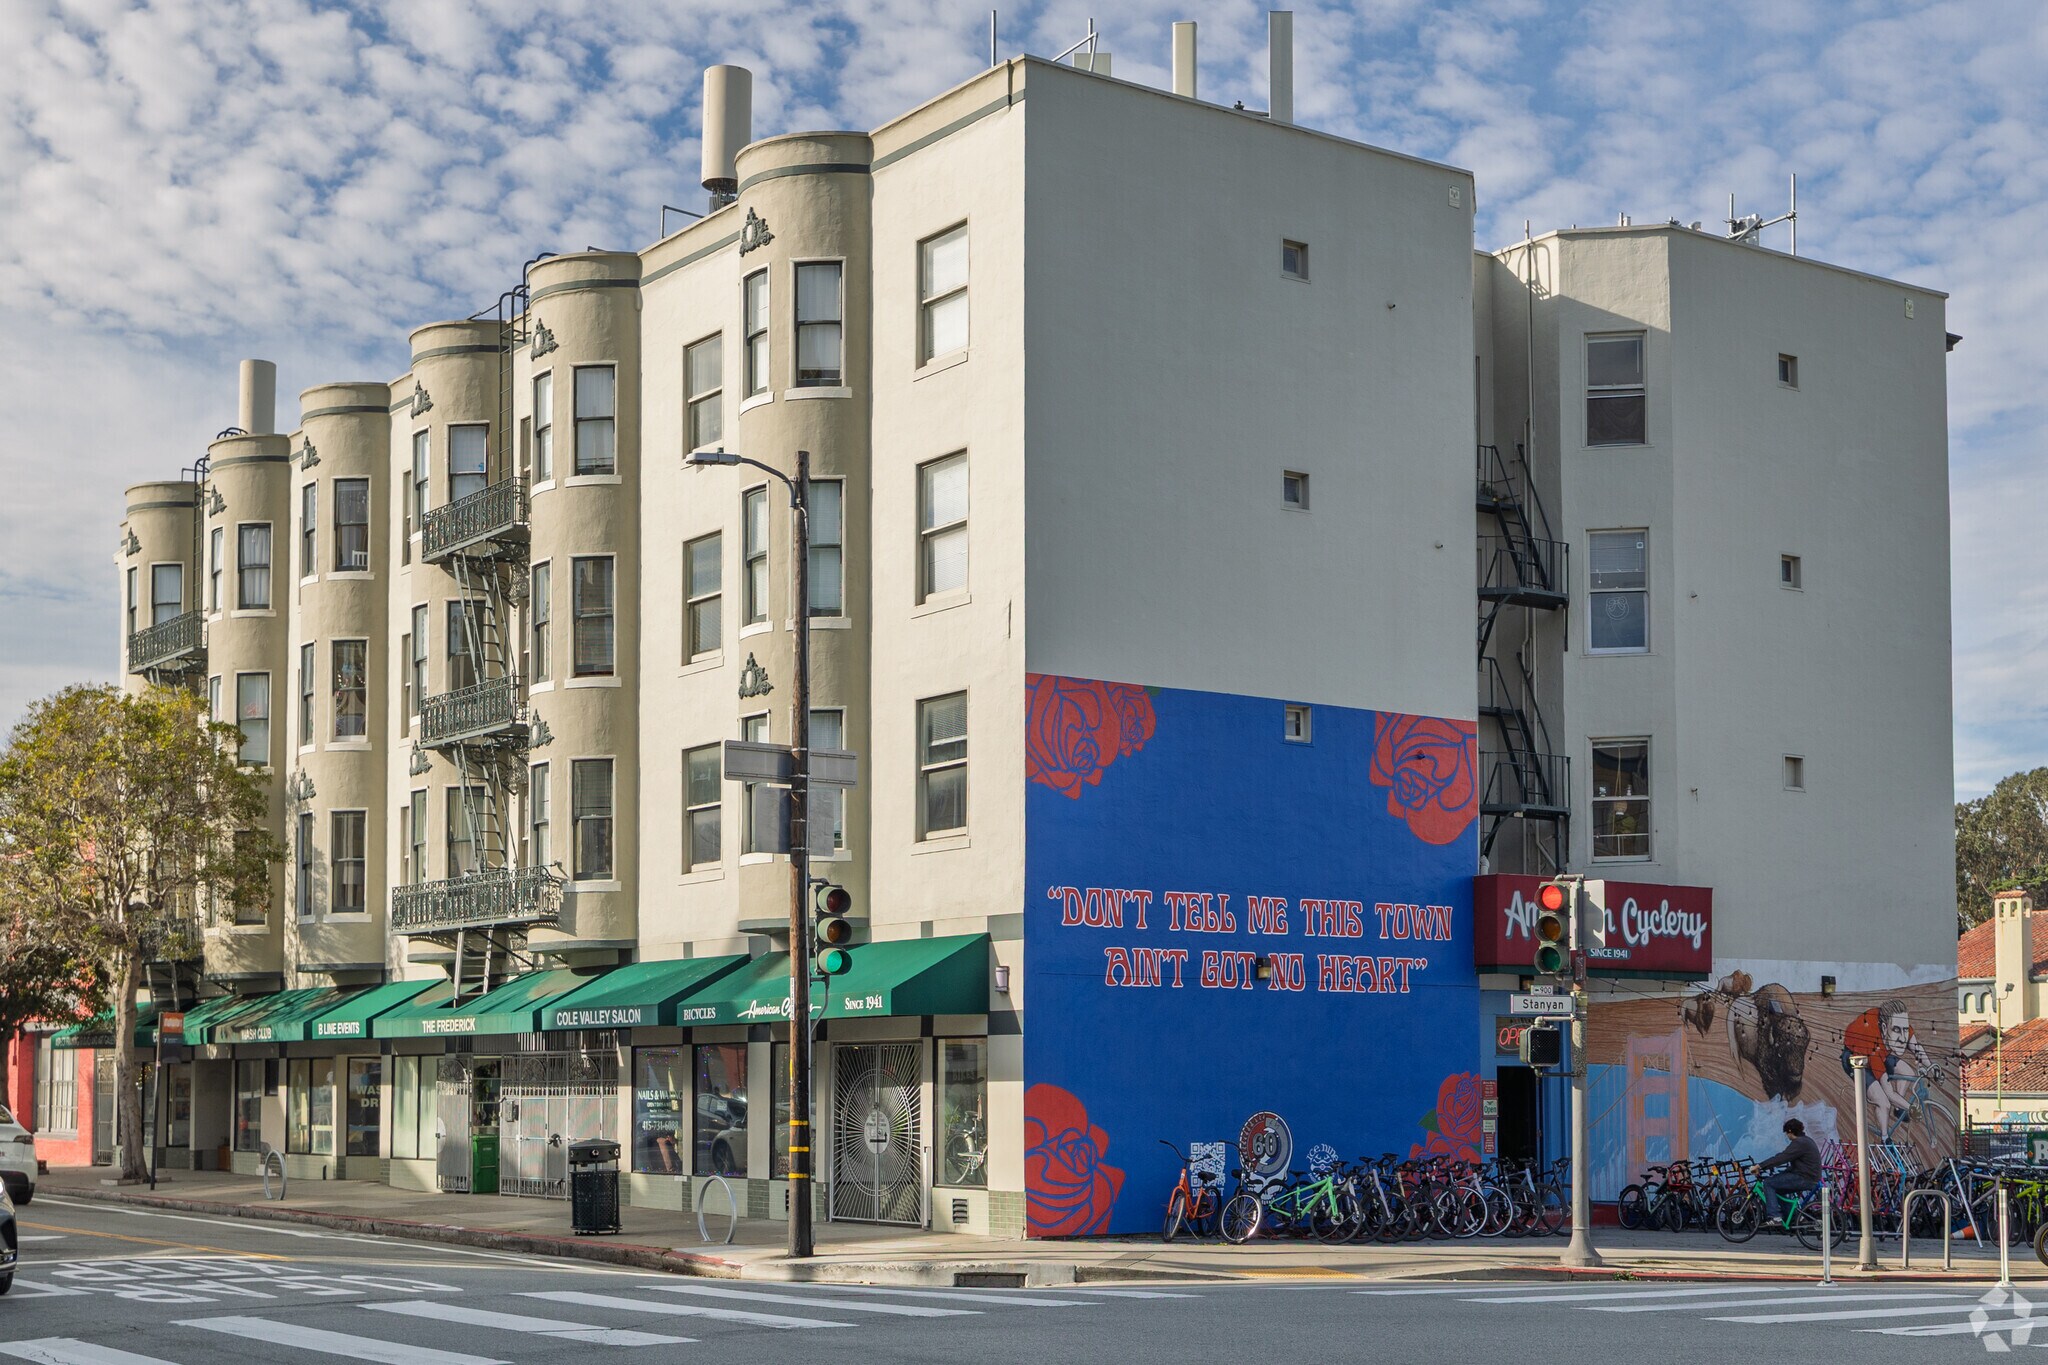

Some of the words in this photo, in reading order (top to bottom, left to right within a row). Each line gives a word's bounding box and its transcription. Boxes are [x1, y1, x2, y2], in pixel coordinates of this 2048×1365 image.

[1164, 891, 1237, 934] TELL
[1247, 895, 1289, 935] ME
[1300, 899, 1363, 938] THIS
[1375, 902, 1453, 941] TOWN
[1622, 896, 1708, 949] Cyclery
[1590, 948, 1612, 958] SINCE
[1613, 949, 1628, 959] 1941
[1201, 950, 1257, 990] GOT
[1267, 951, 1306, 992] NO
[1540, 986, 1552, 994] 900
[737, 999, 781, 1019] American
[865, 994, 883, 1010] 1941
[1522, 998, 1564, 1012] Stanyan
[556, 1011, 579, 1026] COLE
[579, 1009, 611, 1025] VALLEY
[611, 1008, 642, 1024] SALON
[683, 1007, 716, 1021] BICYCLES
[318, 1023, 324, 1035] B
[324, 1022, 337, 1035] LINE
[337, 1021, 360, 1034] EVENTS
[422, 1020, 436, 1033] THE
[436, 1017, 476, 1033] FREDERICK
[257, 1027, 272, 1040] CLUB
[1499, 1027, 1526, 1046] OPE
[356, 1085, 381, 1095] WAS
[637, 1090, 654, 1101] NAILS
[654, 1090, 659, 1101] &
[659, 1090, 683, 1101] WANG
[361, 1098, 380, 1108] DR
[1484, 1105, 1497, 1114] Open
[51, 1258, 320, 1281] KEEP
[68, 1274, 464, 1302] CLEAR
